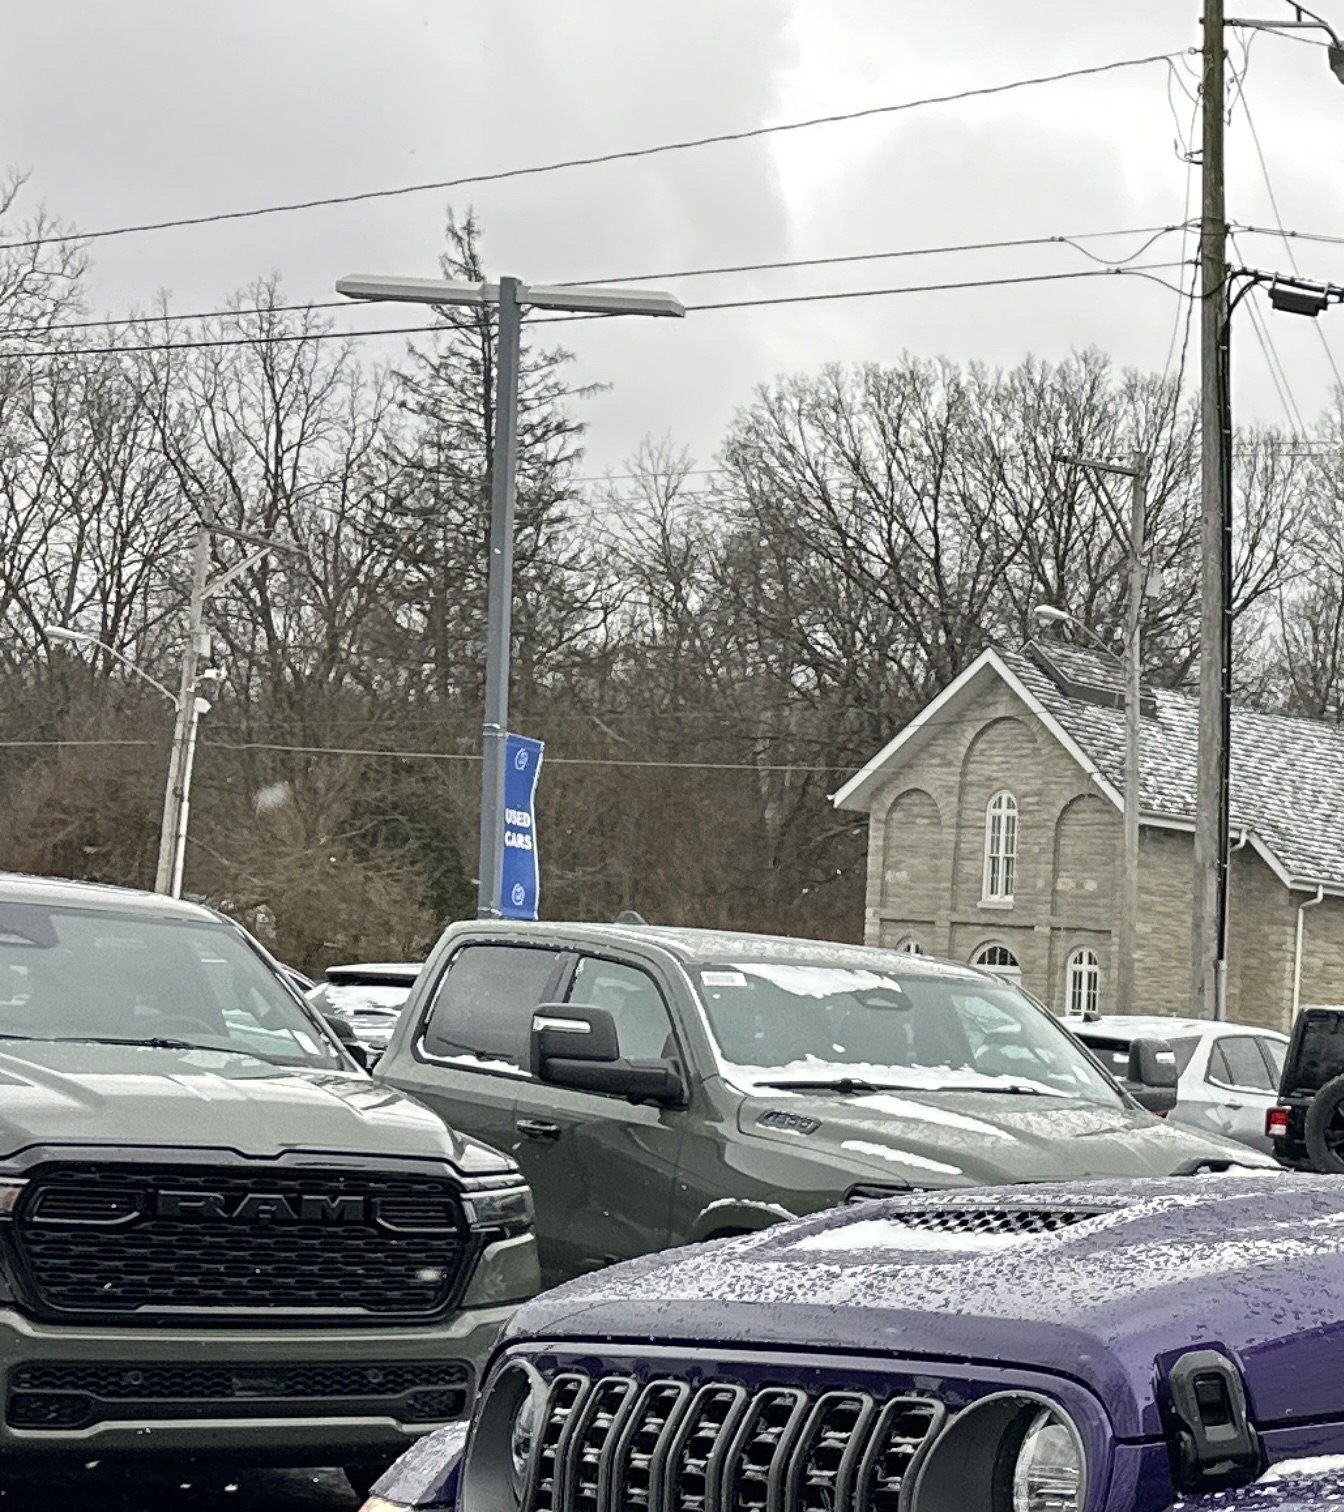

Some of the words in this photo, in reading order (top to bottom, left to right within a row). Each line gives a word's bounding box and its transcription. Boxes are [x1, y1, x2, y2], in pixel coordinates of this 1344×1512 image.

[505, 808, 531, 828] USED
[504, 830, 532, 850] CARS
[157, 1189, 365, 1220] RAM
